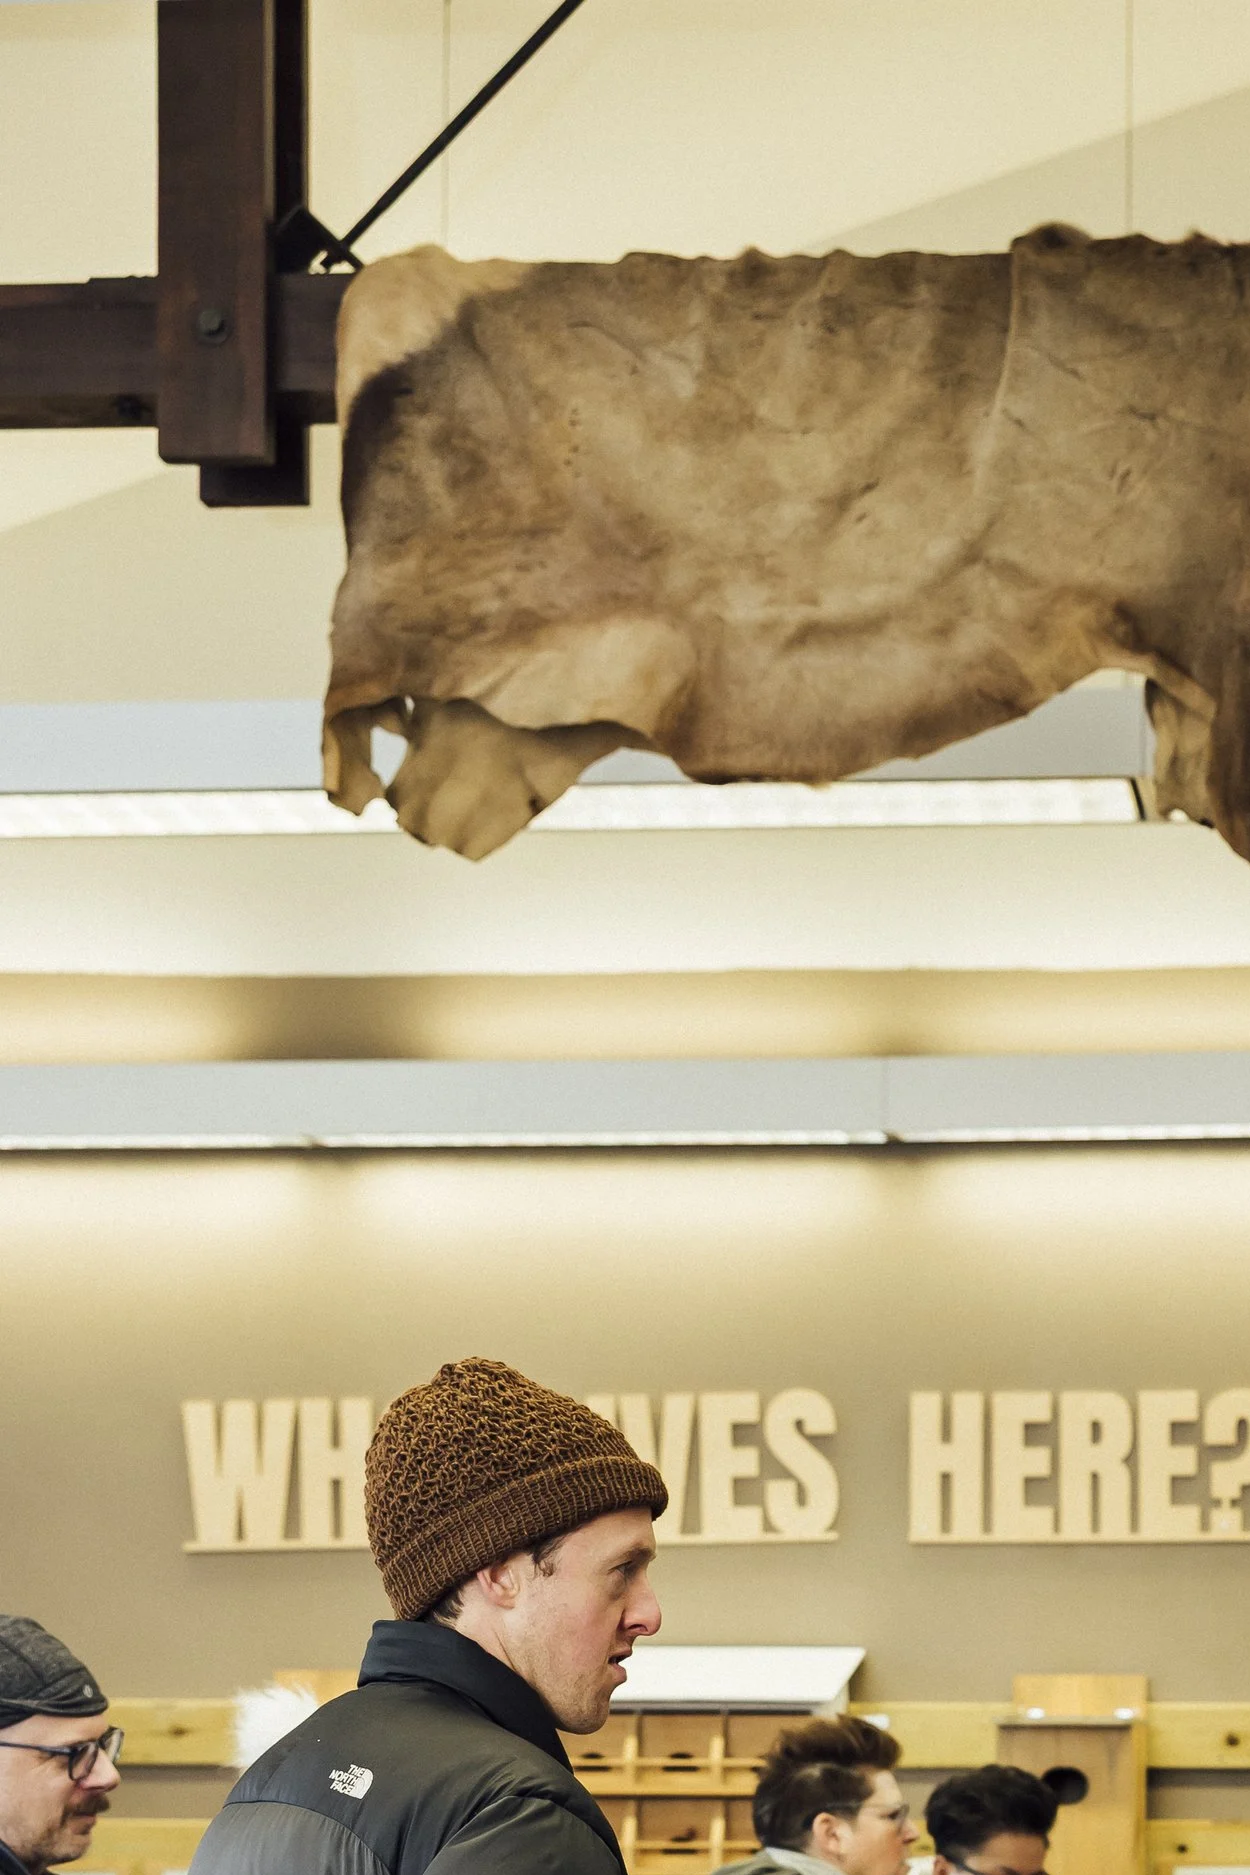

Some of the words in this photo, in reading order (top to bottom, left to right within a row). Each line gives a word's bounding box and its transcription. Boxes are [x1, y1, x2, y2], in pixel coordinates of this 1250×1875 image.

[180, 1397, 374, 1551] WH
[328, 1769, 358, 1786] NORTH
[348, 1764, 366, 1777] THE
[329, 1780, 356, 1795] FACE
